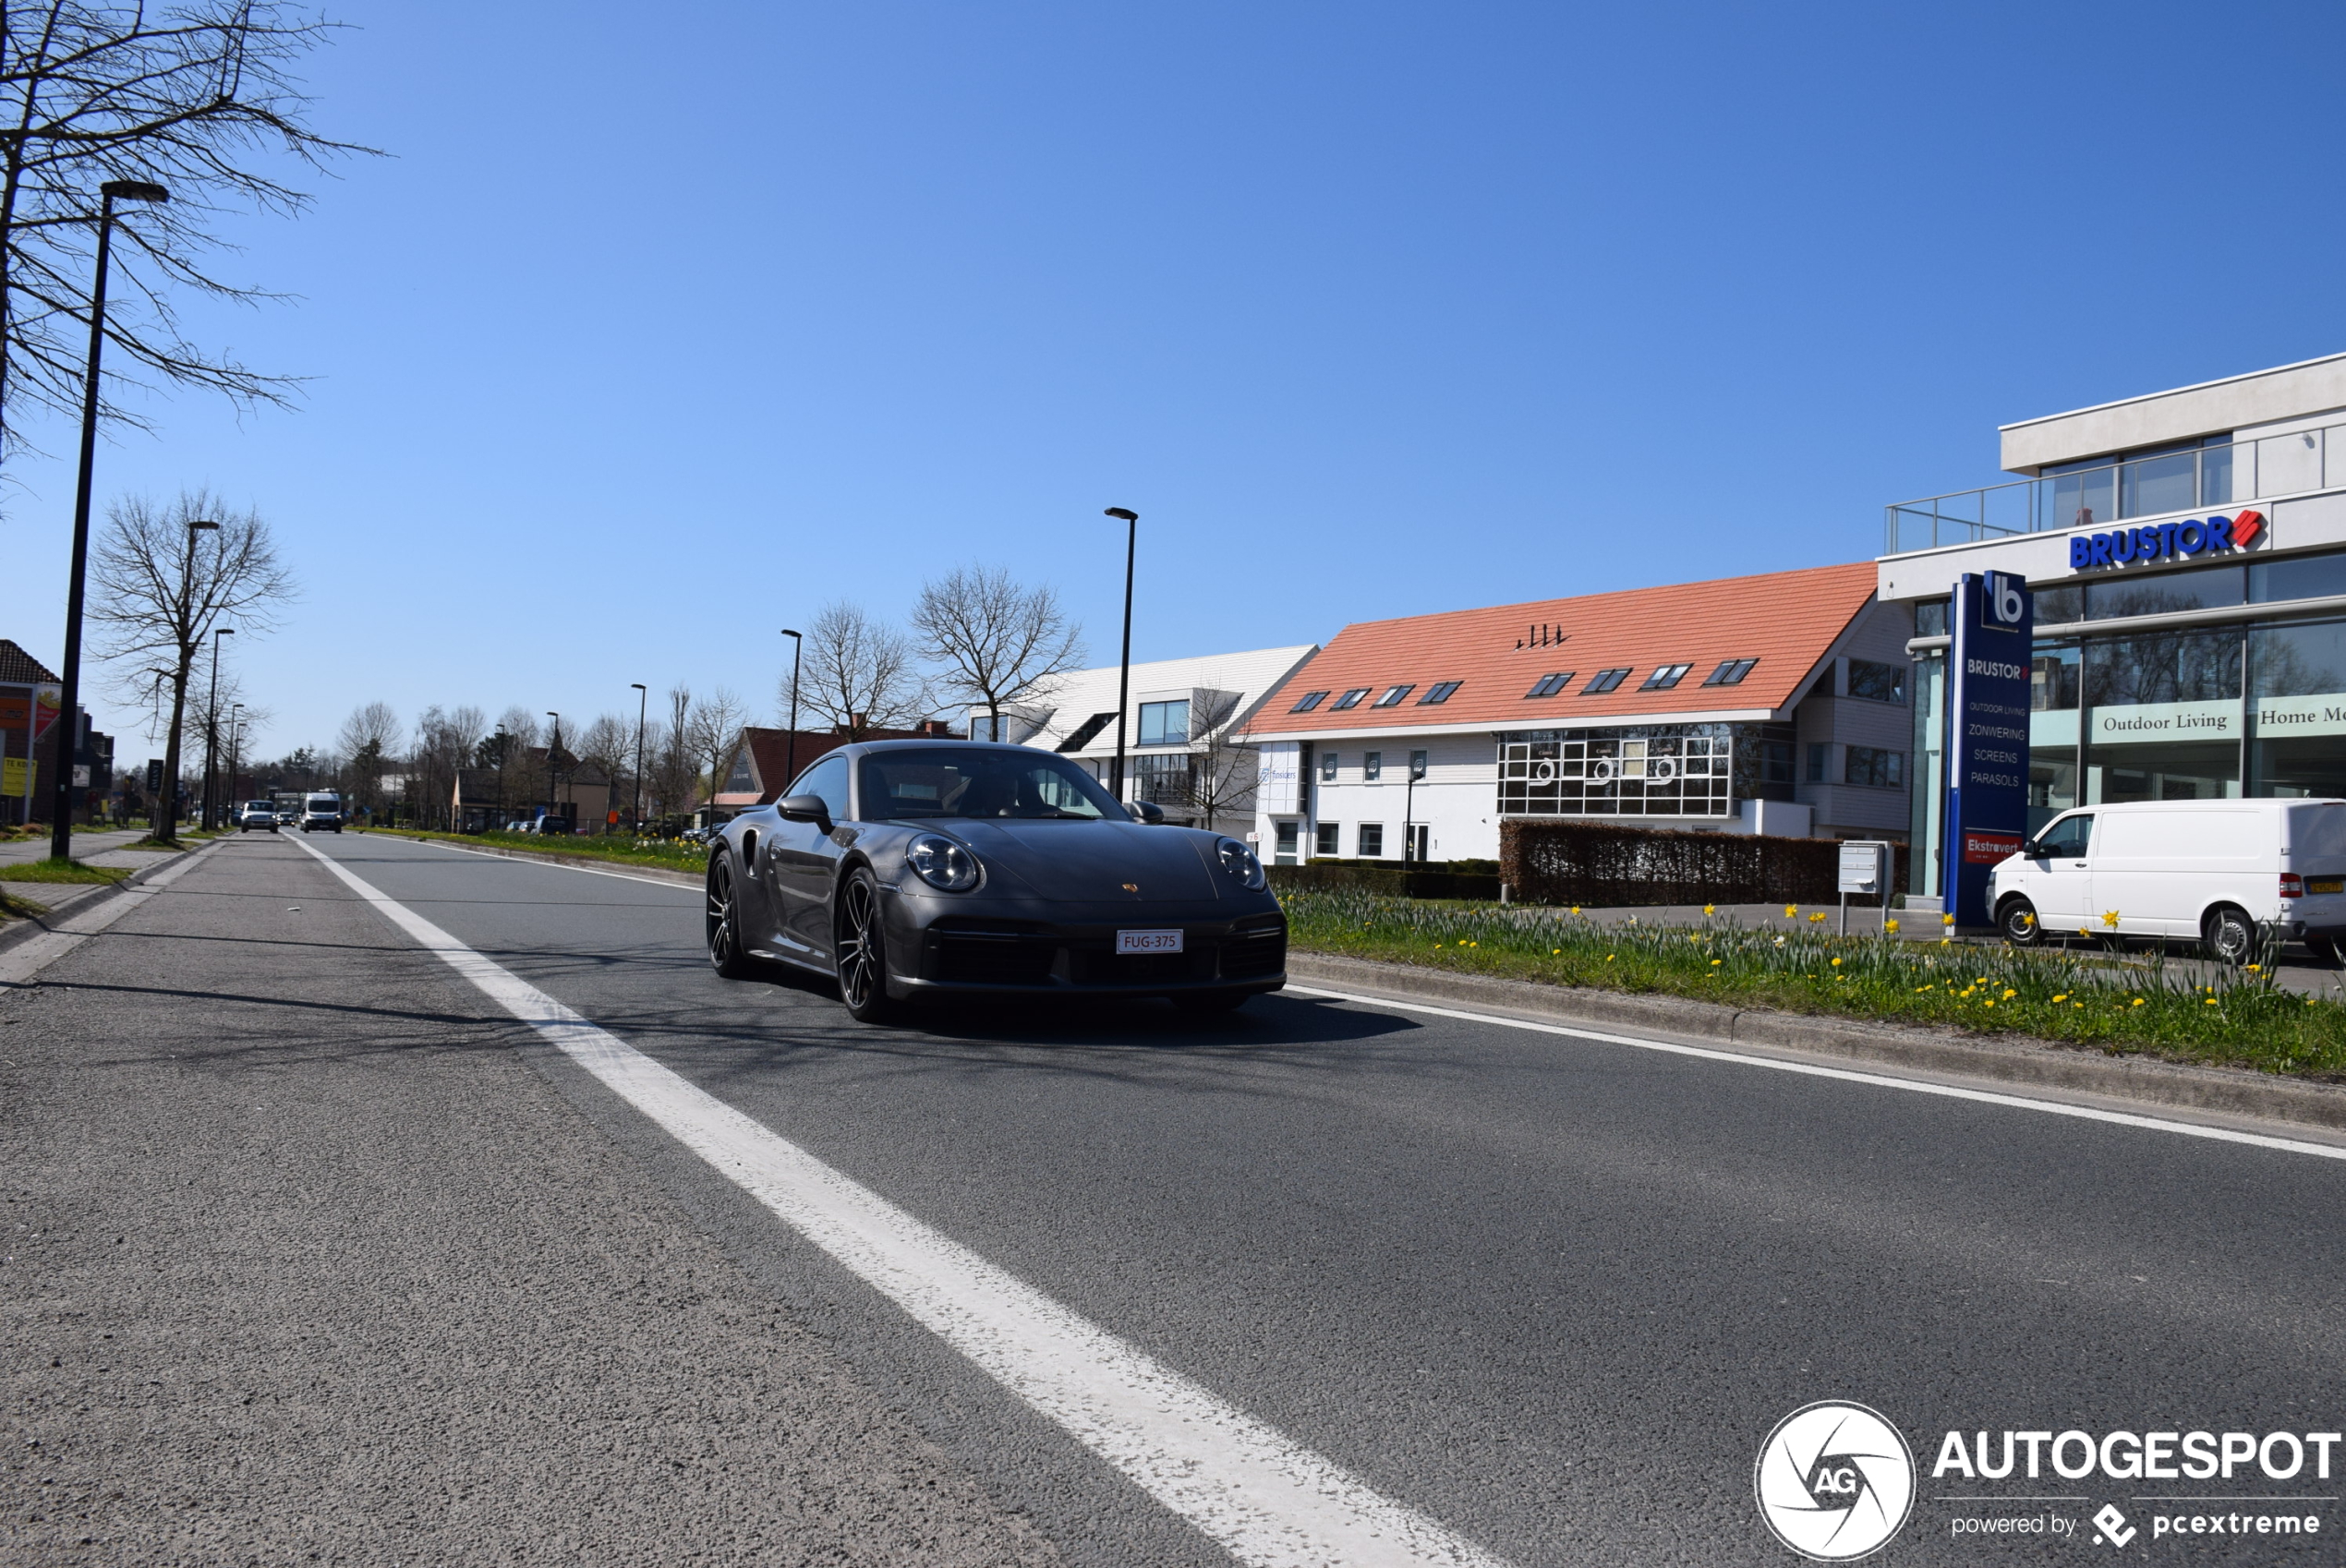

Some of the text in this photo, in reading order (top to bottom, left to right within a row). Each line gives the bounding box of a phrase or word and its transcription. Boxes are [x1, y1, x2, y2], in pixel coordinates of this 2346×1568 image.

[2070, 515, 2232, 569] BRUSTOR
[1967, 658, 2021, 680] BRUSTOR
[1969, 702, 2026, 717] OUTDOOR LIVING
[2103, 713, 2228, 731] Outdoor Living
[2259, 710, 2316, 726] Home
[1968, 723, 2026, 741] ZONWERING
[1974, 749, 2018, 764] SCREENS
[1970, 771, 2019, 787] PARASOLS
[1967, 838, 2018, 854] Ekstravert
[1124, 935, 1176, 948] FUG-375
